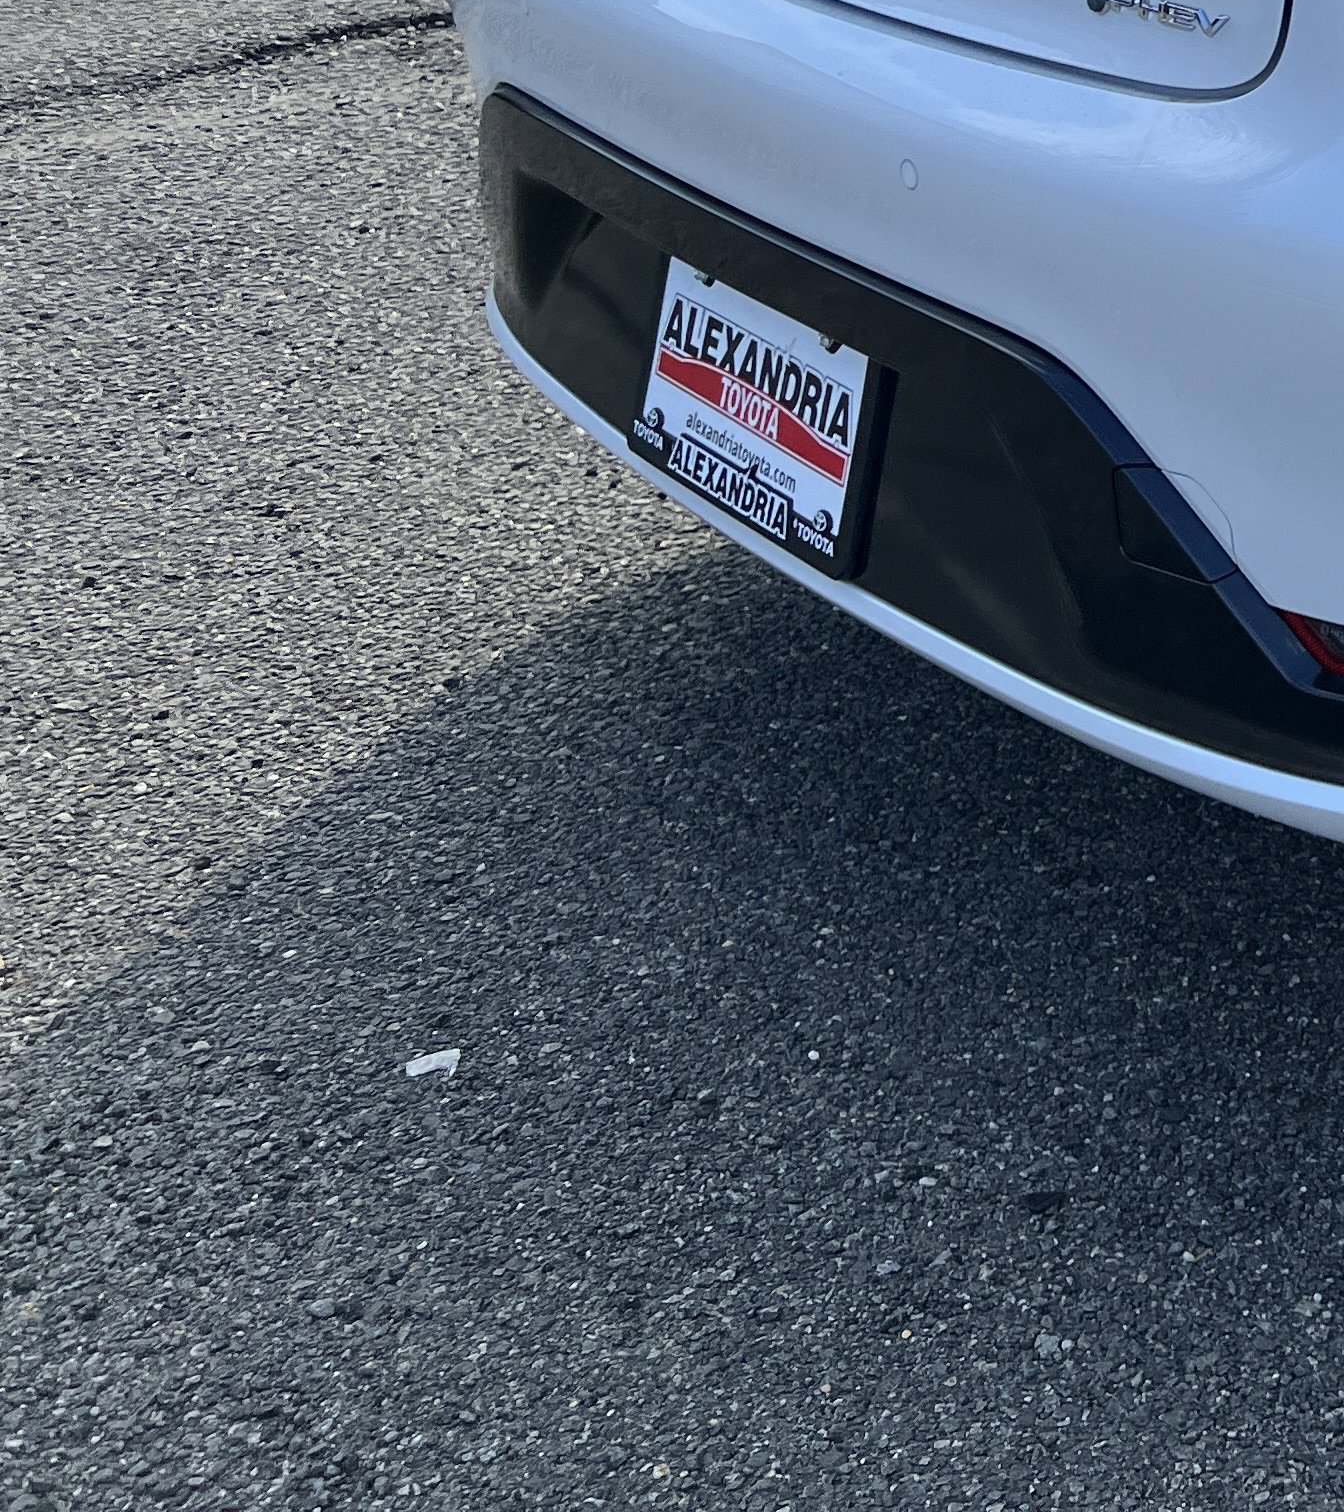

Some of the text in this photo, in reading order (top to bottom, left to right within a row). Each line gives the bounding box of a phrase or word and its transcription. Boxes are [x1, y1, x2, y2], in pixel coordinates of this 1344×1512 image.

[663, 297, 852, 448] ALEXANDRIA
[719, 376, 780, 441] TOYOTA
[632, 418, 665, 452] TOYOTA
[667, 437, 835, 558] ALEXANDRIA TOYOTA
